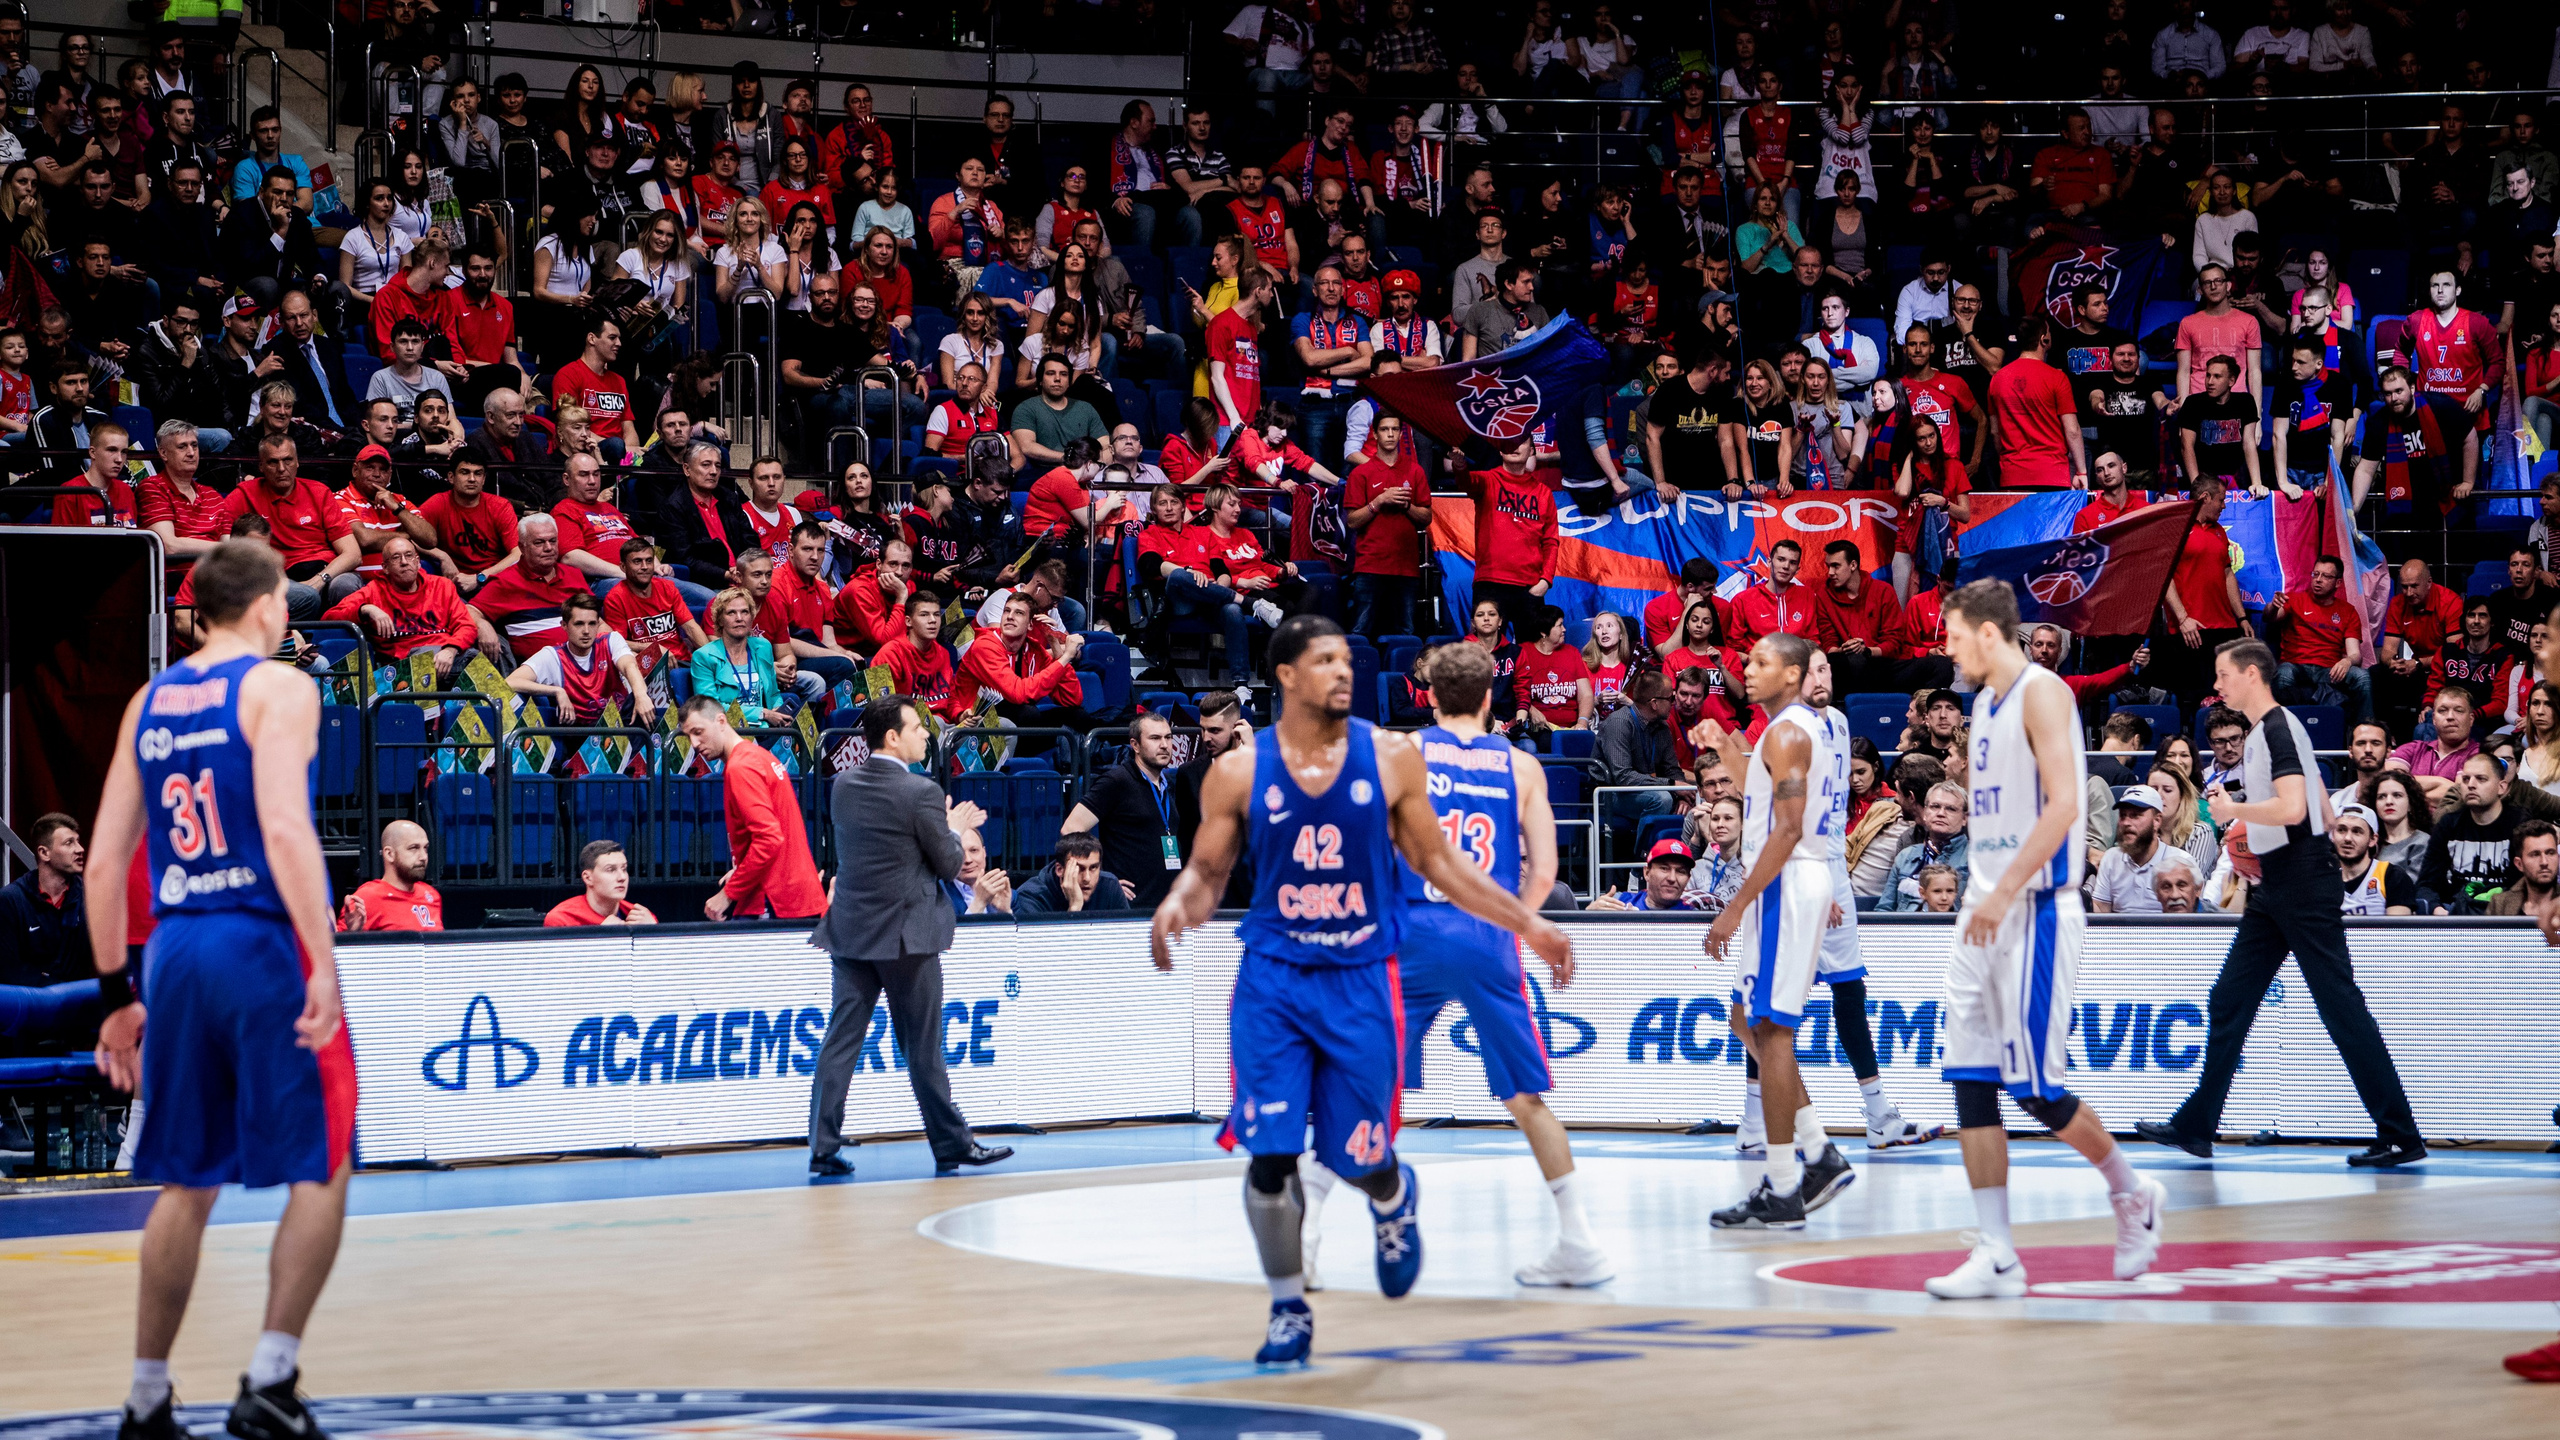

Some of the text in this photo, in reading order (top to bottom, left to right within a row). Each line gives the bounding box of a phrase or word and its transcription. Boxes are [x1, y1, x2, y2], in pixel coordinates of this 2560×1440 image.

[1831, 154, 1862, 170] CSKA
[1253, 222, 1276, 240] 10
[2057, 271, 2110, 291] CSKA
[2438, 345, 2449, 364] 7
[2426, 367, 2463, 383] CSKA
[598, 394, 625, 410] CSKA
[1470, 386, 1530, 415] CSKA
[2403, 430, 2426, 455] SK
[1557, 490, 1899, 538] SUPPOR
[921, 535, 959, 562] CSKA
[1976, 736, 1990, 771] 3
[161, 767, 229, 862] 31
[1292, 823, 1344, 871] 42
[1437, 808, 1496, 875] 13
[1278, 881, 1368, 920] CSKA
[411, 904, 436, 928] 12
